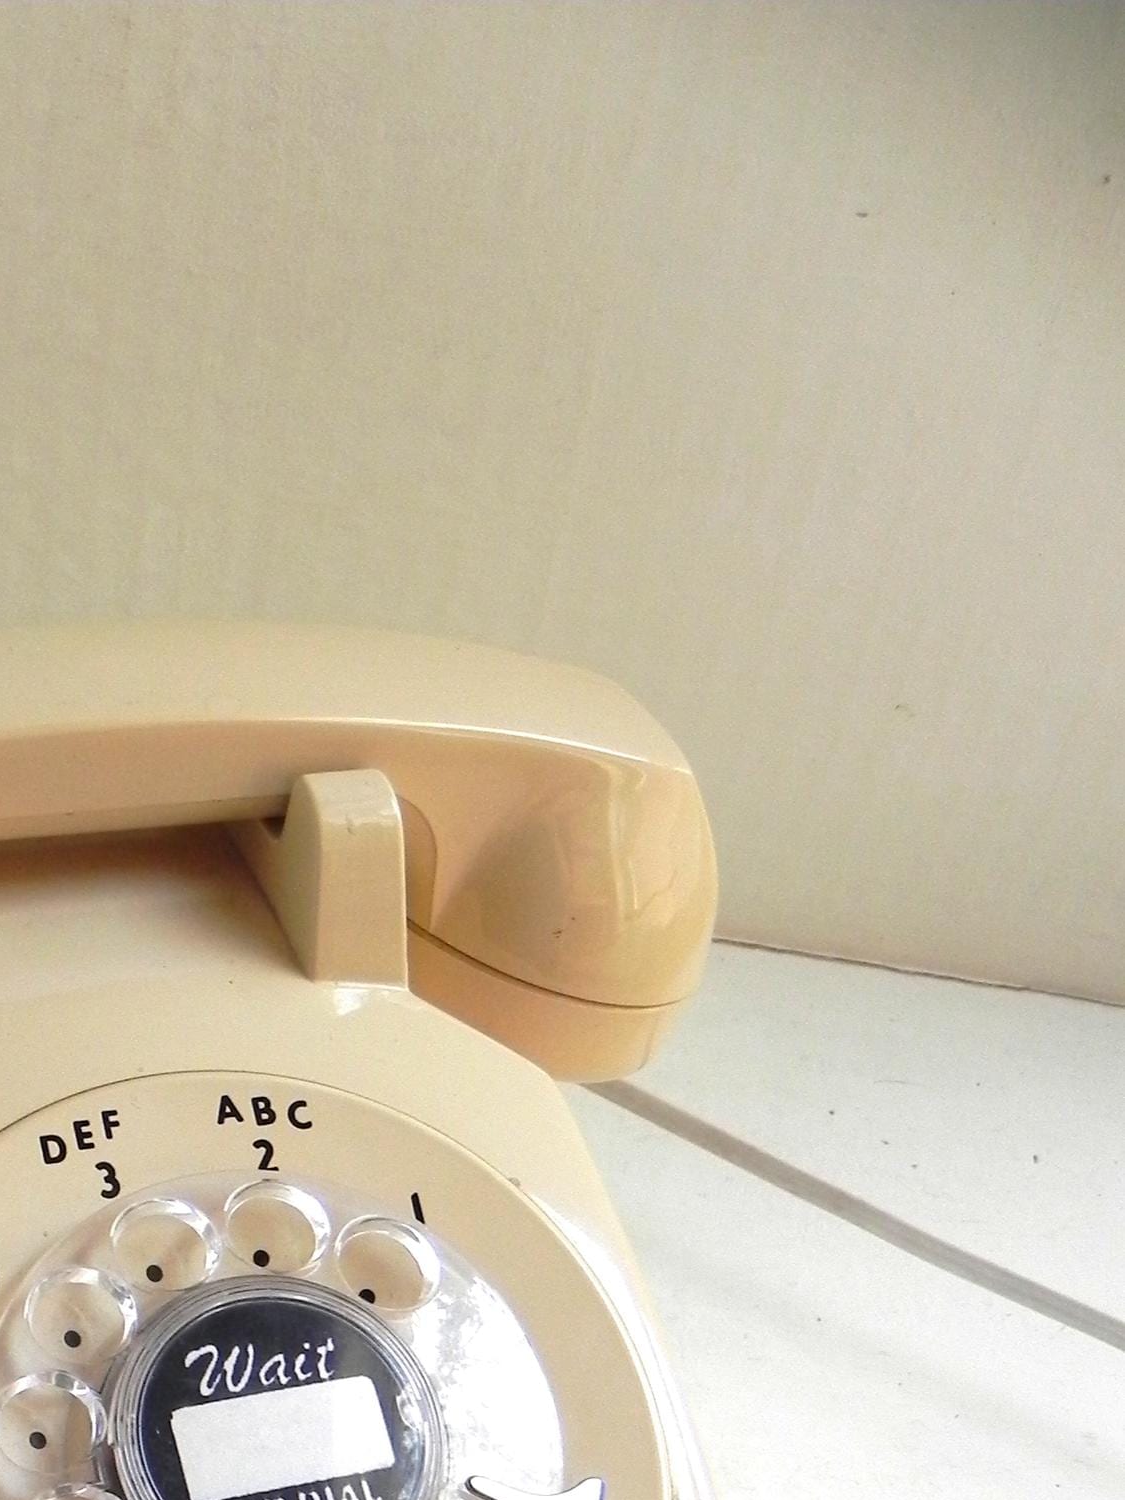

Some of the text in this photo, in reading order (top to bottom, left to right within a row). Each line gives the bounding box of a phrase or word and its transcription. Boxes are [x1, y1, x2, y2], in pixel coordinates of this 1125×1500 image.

[216, 1094, 313, 1130] ABC
[39, 1109, 121, 1165] DEF
[252, 1138, 280, 1172] 2
[94, 1161, 121, 1200] 3
[184, 1337, 336, 1398] Wait
